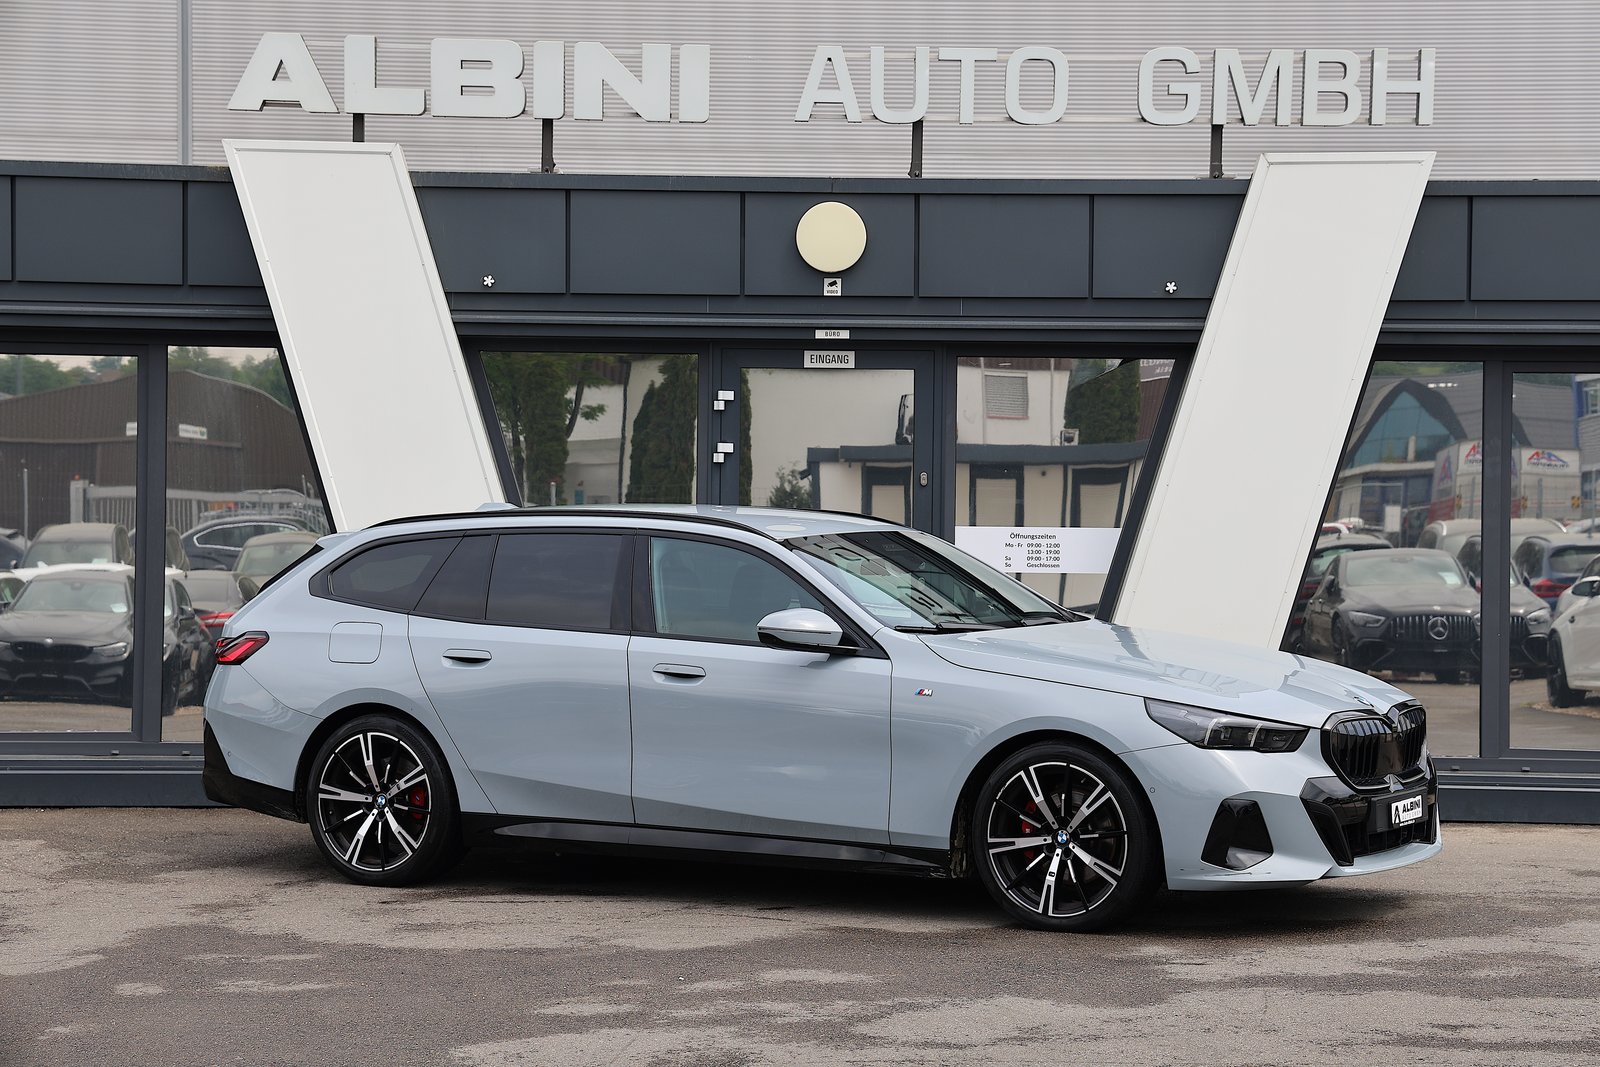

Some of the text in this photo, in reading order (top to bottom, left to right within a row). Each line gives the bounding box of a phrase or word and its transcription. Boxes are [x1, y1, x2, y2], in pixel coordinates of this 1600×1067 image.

[227, 32, 1436, 127] ALBINI AUTO GMBH
[810, 354, 849, 364] EINGANG
